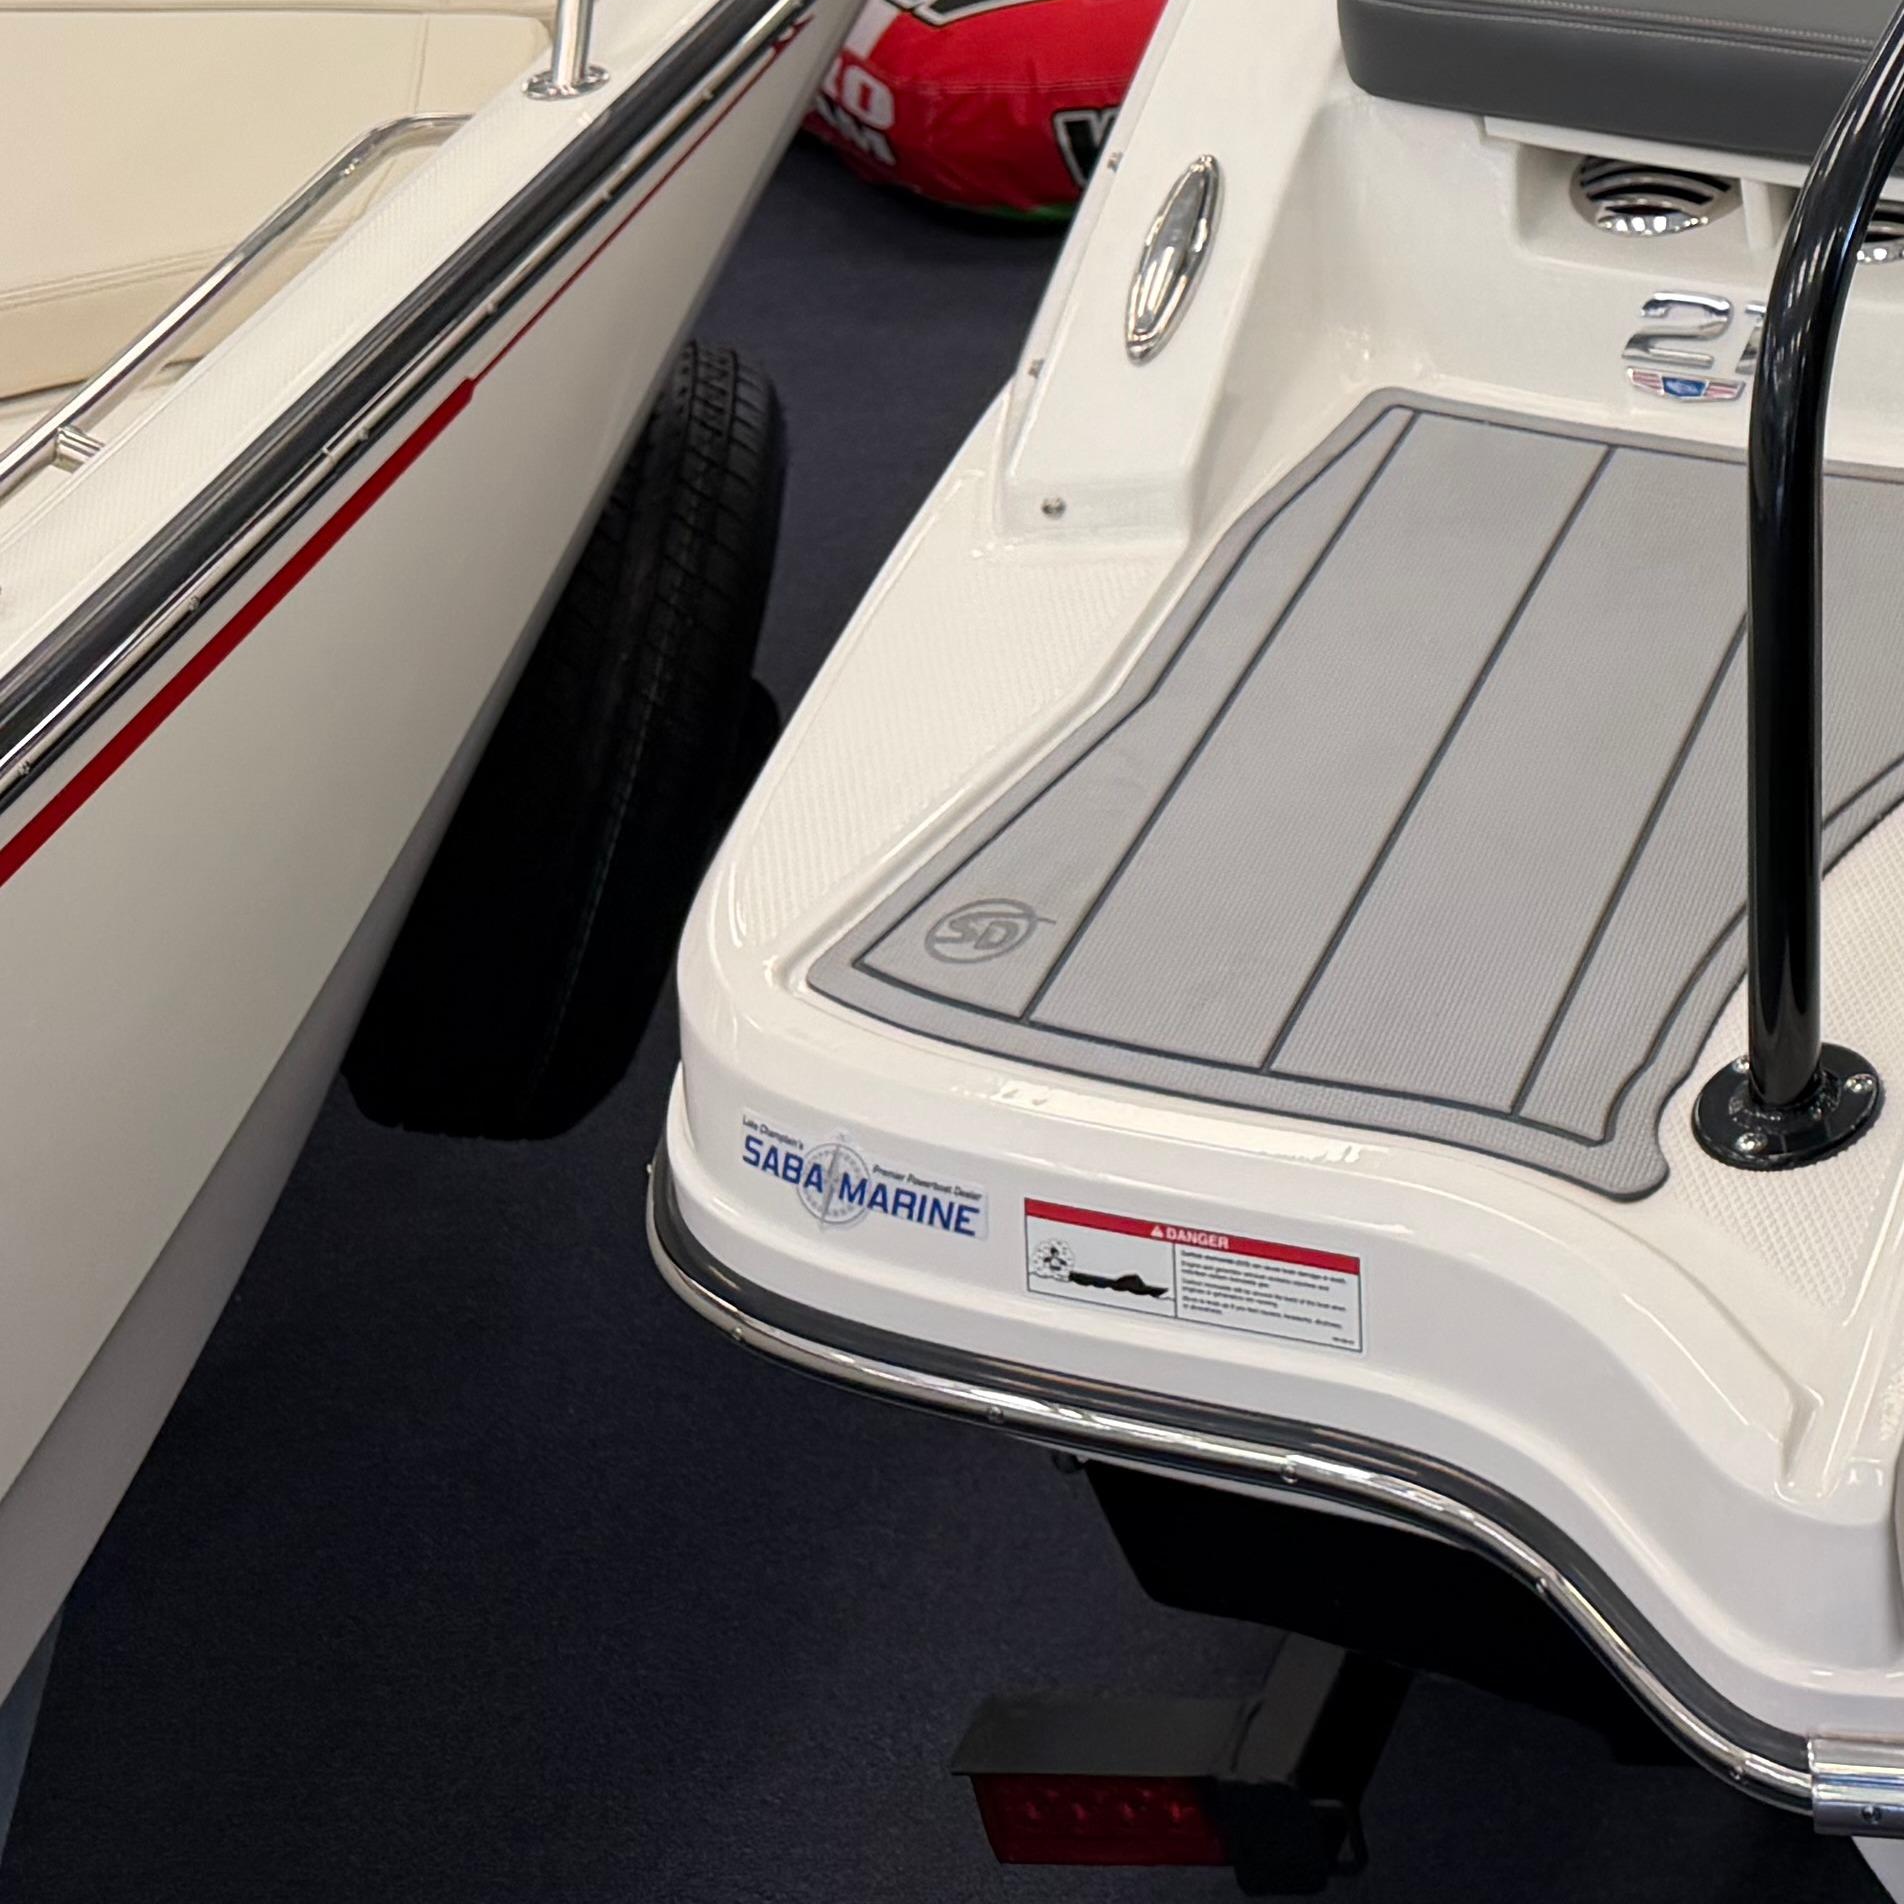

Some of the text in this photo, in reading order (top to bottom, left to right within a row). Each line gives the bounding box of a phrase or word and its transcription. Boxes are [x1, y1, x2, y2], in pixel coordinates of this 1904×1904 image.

[743, 1134, 981, 1238] SABA MARINE
[1166, 1226, 1229, 1250] DANGER
